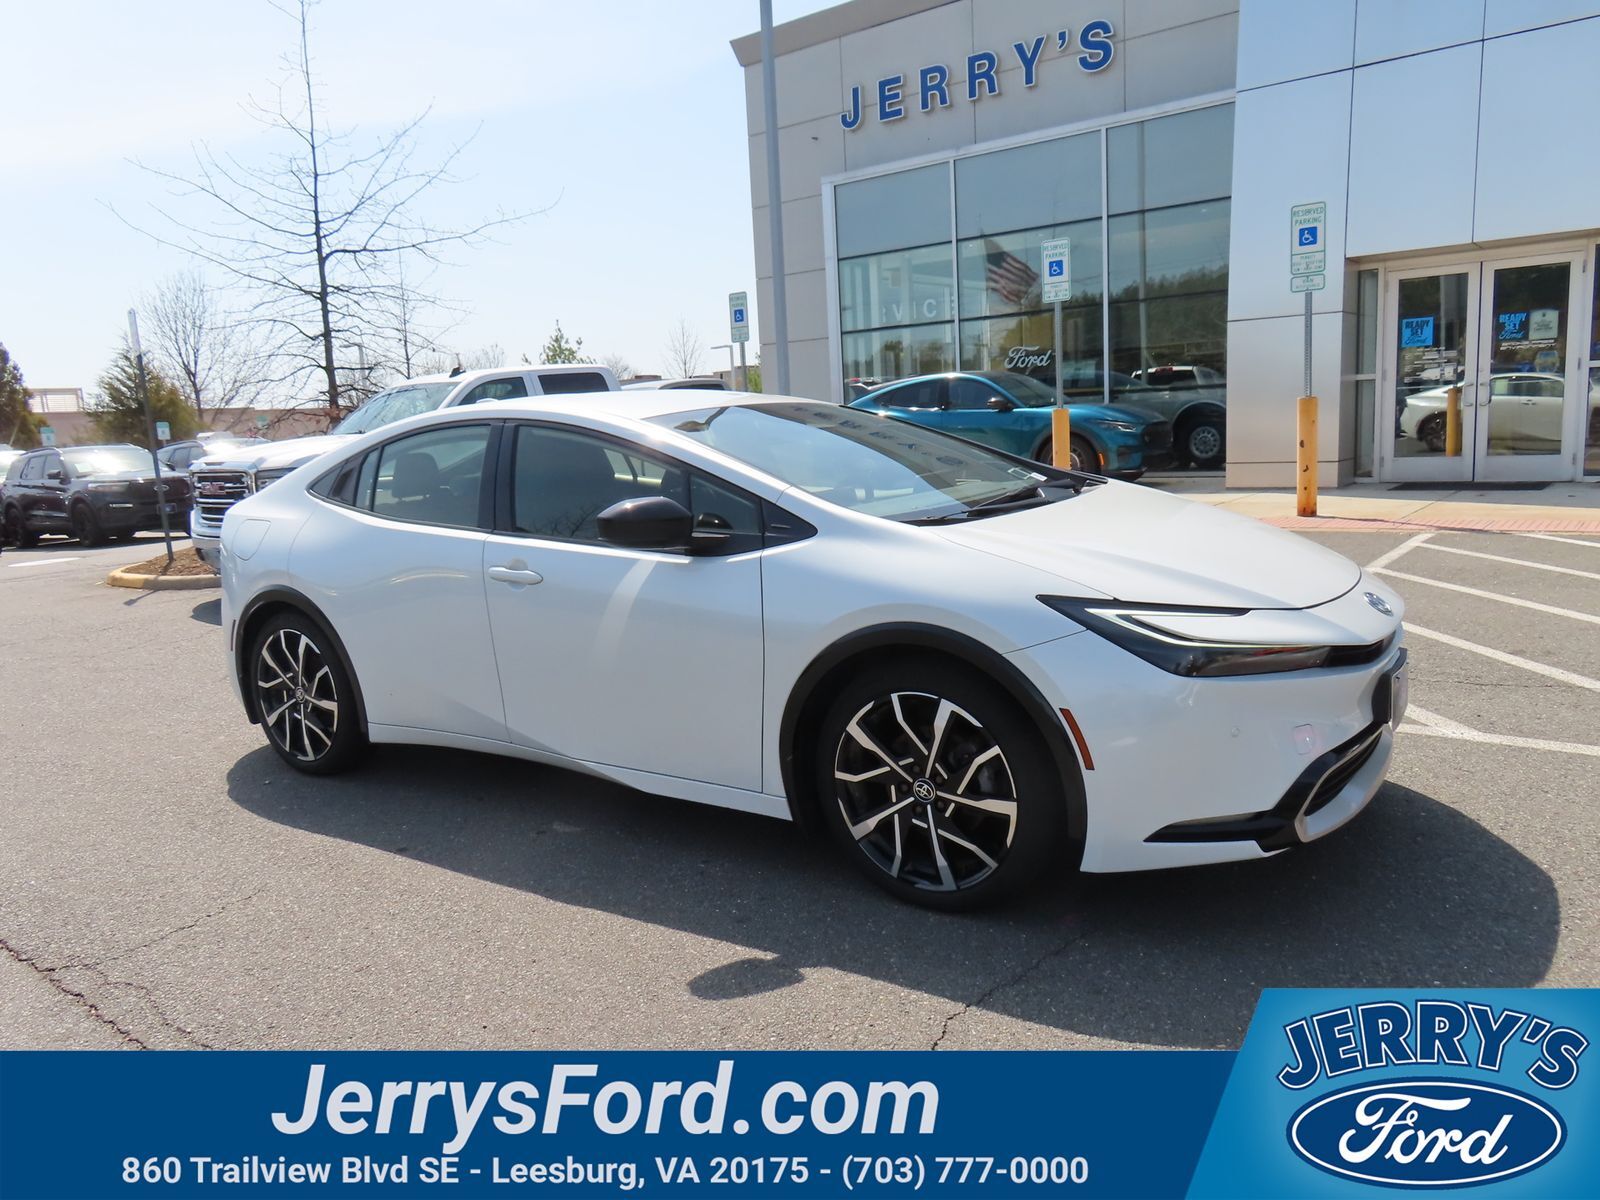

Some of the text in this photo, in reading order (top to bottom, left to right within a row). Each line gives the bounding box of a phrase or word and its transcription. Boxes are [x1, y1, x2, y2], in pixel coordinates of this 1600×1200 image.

[840, 19, 1114, 130] JERRY'S
[1295, 216, 1322, 226] PARKING
[1004, 345, 1052, 369] Ford
